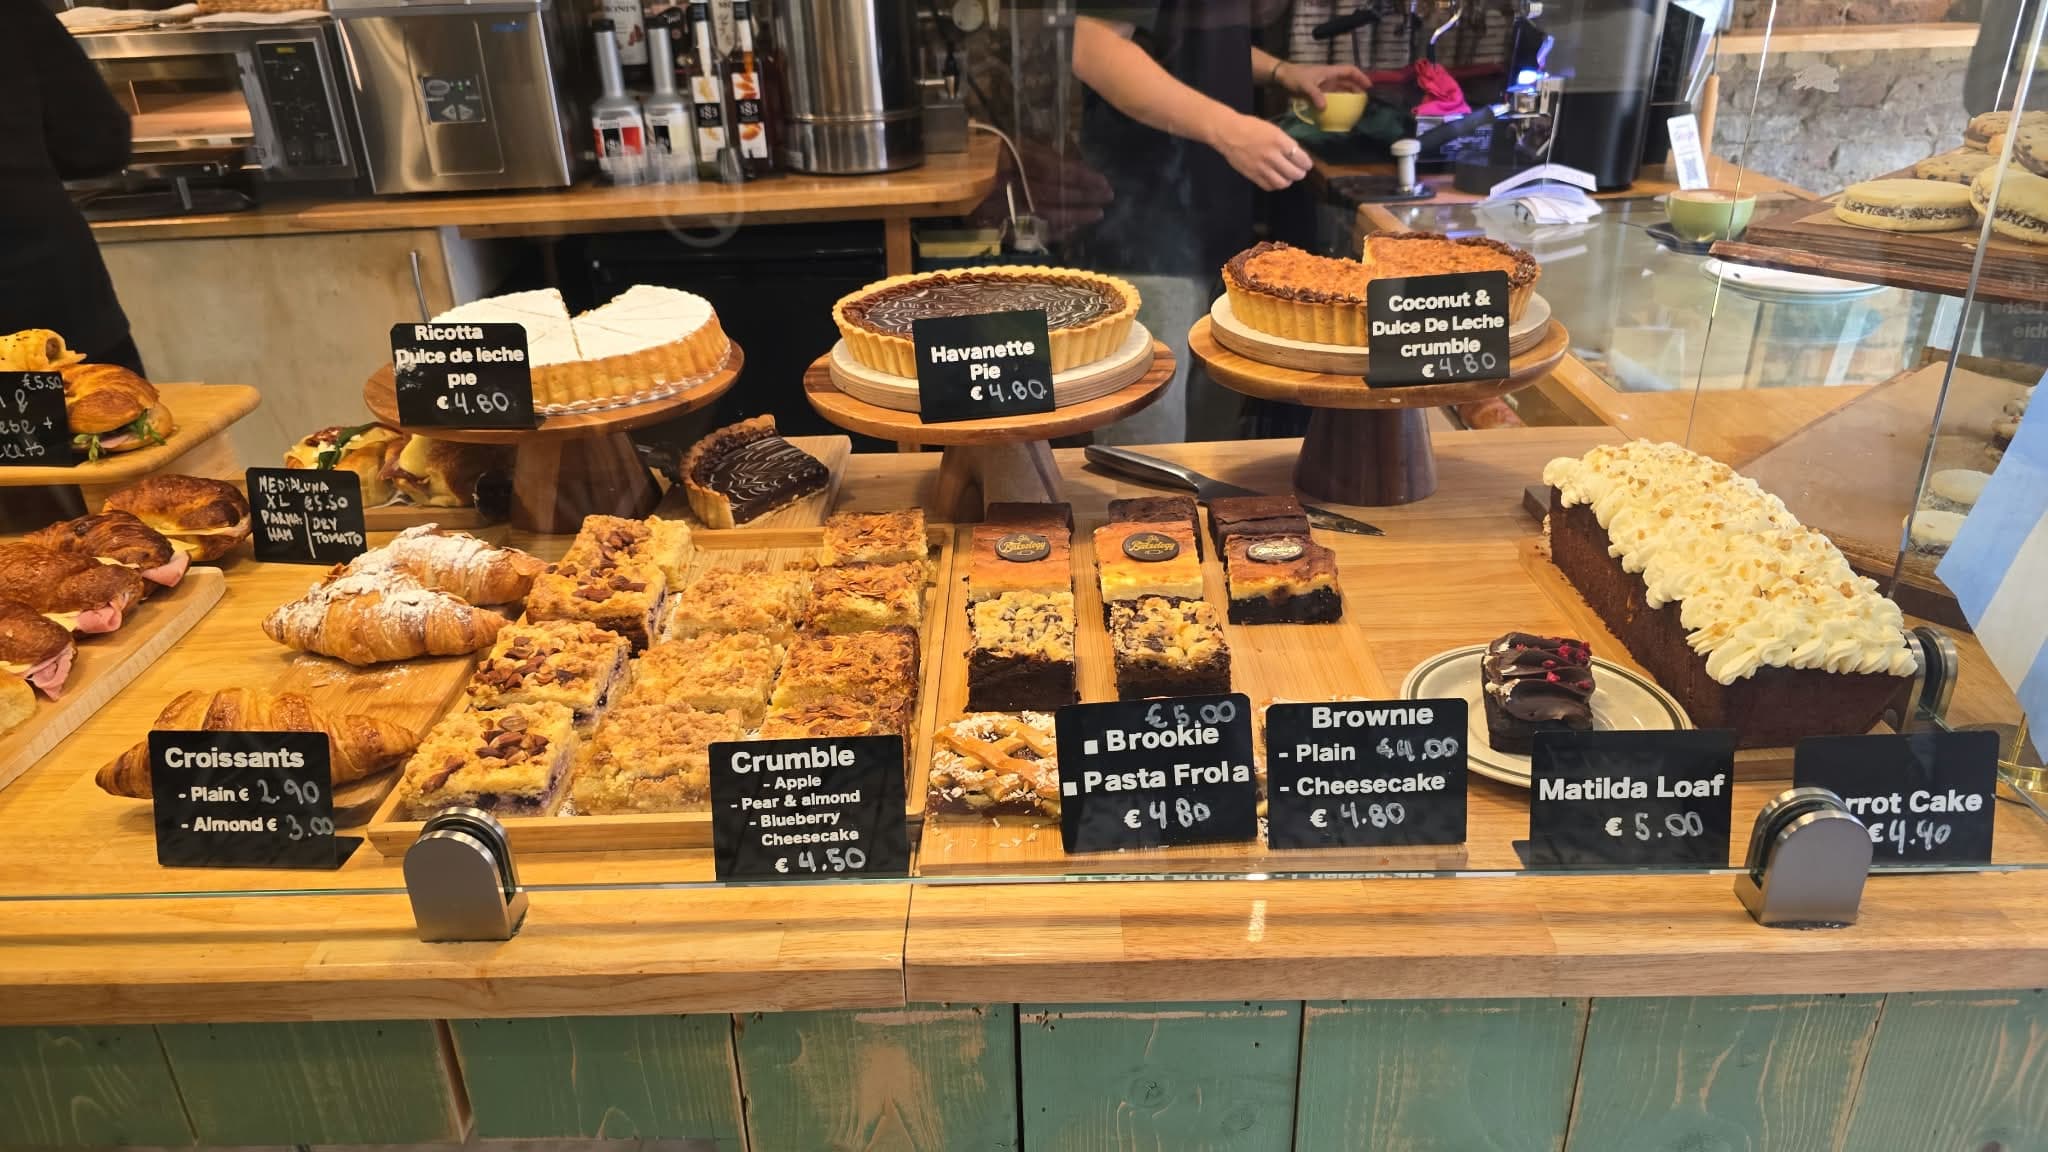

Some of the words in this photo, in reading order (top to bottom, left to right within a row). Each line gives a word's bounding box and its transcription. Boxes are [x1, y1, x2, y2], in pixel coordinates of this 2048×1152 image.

[1388, 291, 1471, 312] Coconut
[1474, 289, 1491, 306] &
[414, 325, 484, 341] Ricotta
[1372, 319, 1421, 336] Dulce
[1424, 317, 1448, 333] De
[1452, 313, 1505, 331] Leche
[395, 348, 446, 364] Dulce
[450, 347, 473, 363] de
[475, 346, 525, 362] leche
[930, 340, 1035, 363] Havanette
[1400, 337, 1481, 357] crumble
[447, 372, 477, 388] pie
[970, 363, 1001, 381] Pie
[266, 527, 294, 542] HAM
[311, 531, 363, 547] TOMATO
[1311, 706, 1434, 729] Brownie
[1105, 724, 1220, 752] Brookie
[165, 747, 305, 768] Croissants
[731, 745, 856, 774] Crumble
[1296, 743, 1356, 763] Plain
[190, 786, 236, 802] Plain
[257, 779, 320, 805] 2.90
[774, 774, 822, 791] Apple
[1083, 768, 1167, 793] Pasta
[1296, 773, 1446, 797] Cheesecake
[1539, 777, 1649, 801] Matilda
[1656, 773, 1726, 798] Loaf
[741, 797, 780, 811] Pear
[783, 794, 798, 808] &
[801, 789, 862, 807] almond
[1908, 789, 1984, 813] Cake
[760, 811, 841, 828] Blueberry
[1340, 801, 1406, 829] 4.80
[1634, 811, 1704, 842] 5.00
[193, 816, 264, 832] Almond
[285, 814, 334, 840] 3.00
[761, 828, 859, 847] Cheesecake
[798, 847, 867, 873] 4.50
